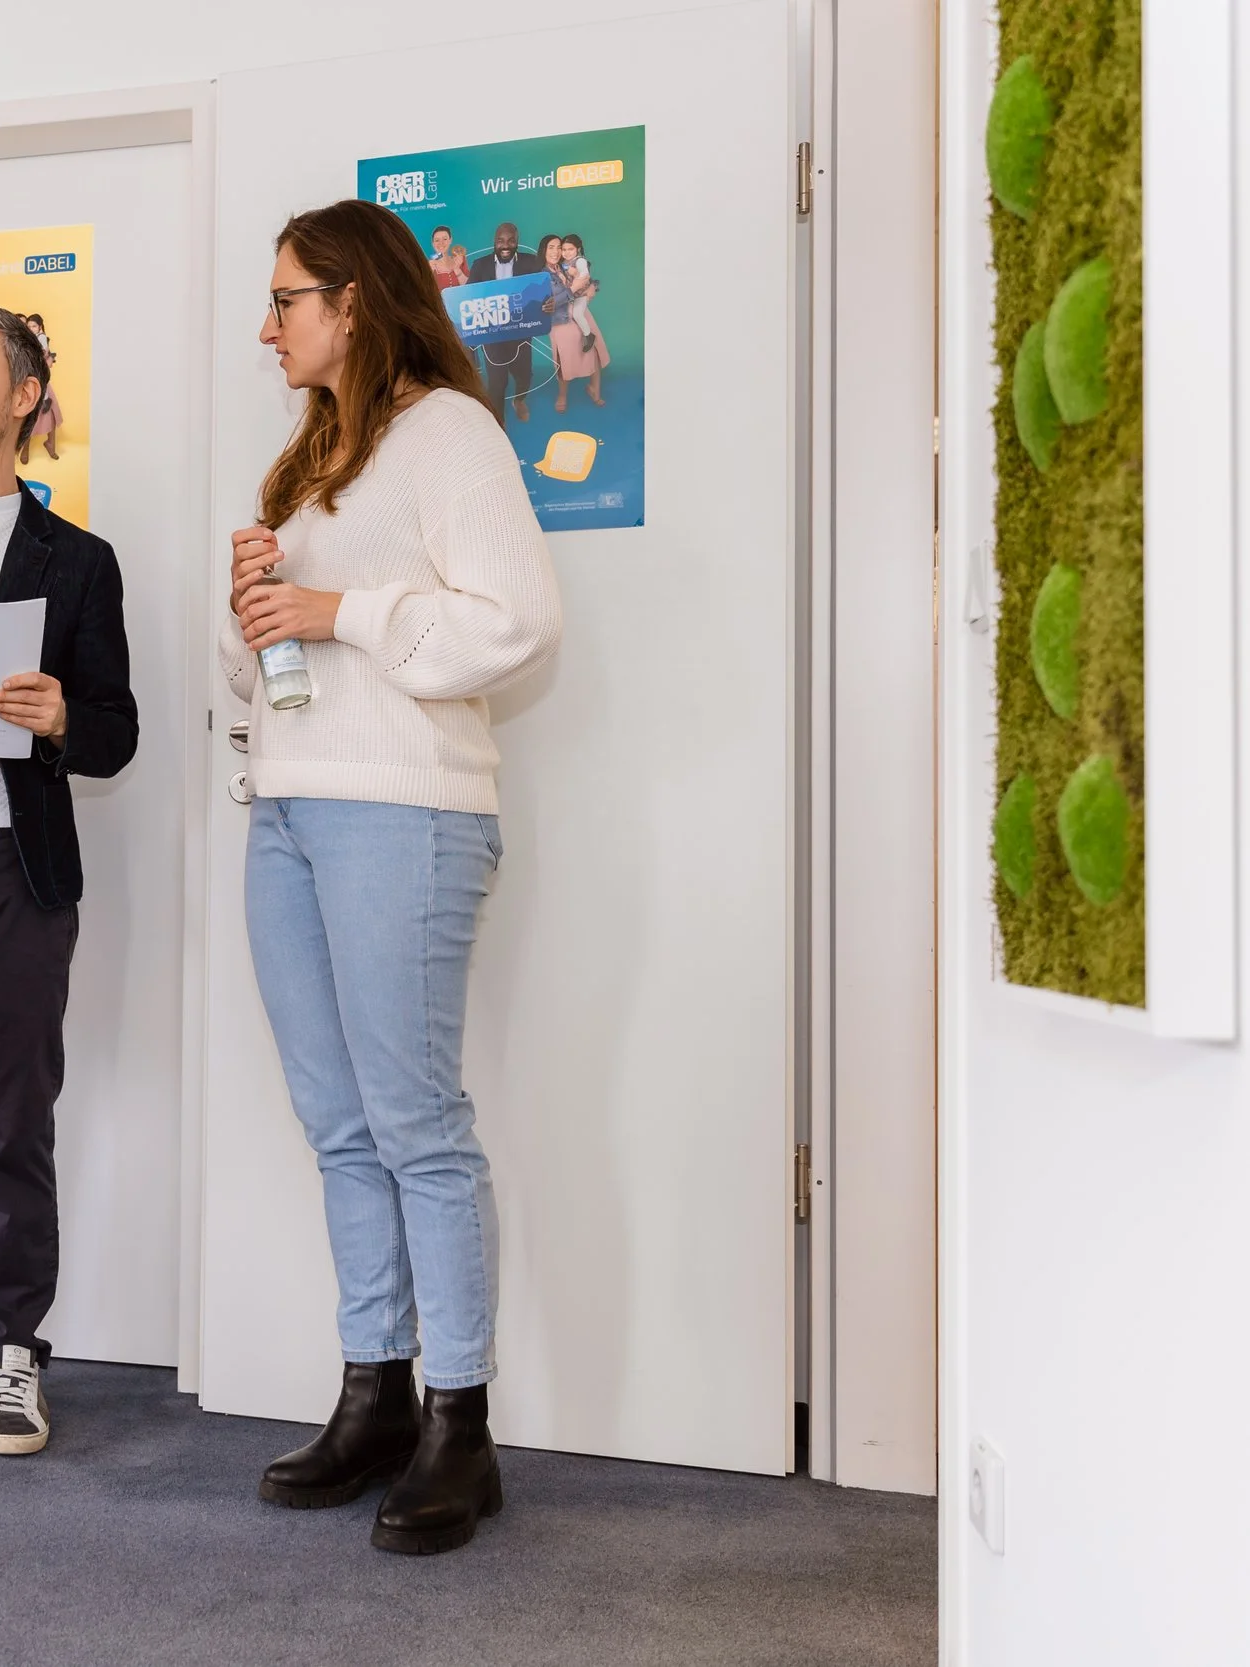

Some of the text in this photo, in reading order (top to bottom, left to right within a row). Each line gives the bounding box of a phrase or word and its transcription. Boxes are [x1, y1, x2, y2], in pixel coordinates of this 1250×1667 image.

[376, 171, 425, 193] OBER
[425, 170, 438, 201] Card
[481, 178, 513, 195] Wir
[517, 171, 555, 190] sind
[376, 185, 426, 207] LAND
[426, 202, 447, 210] Region.
[26, 255, 74, 273] DABEI.
[459, 294, 510, 318] OBER
[511, 292, 524, 323] Card
[461, 309, 511, 331] LAND
[519, 321, 543, 329] Region.
